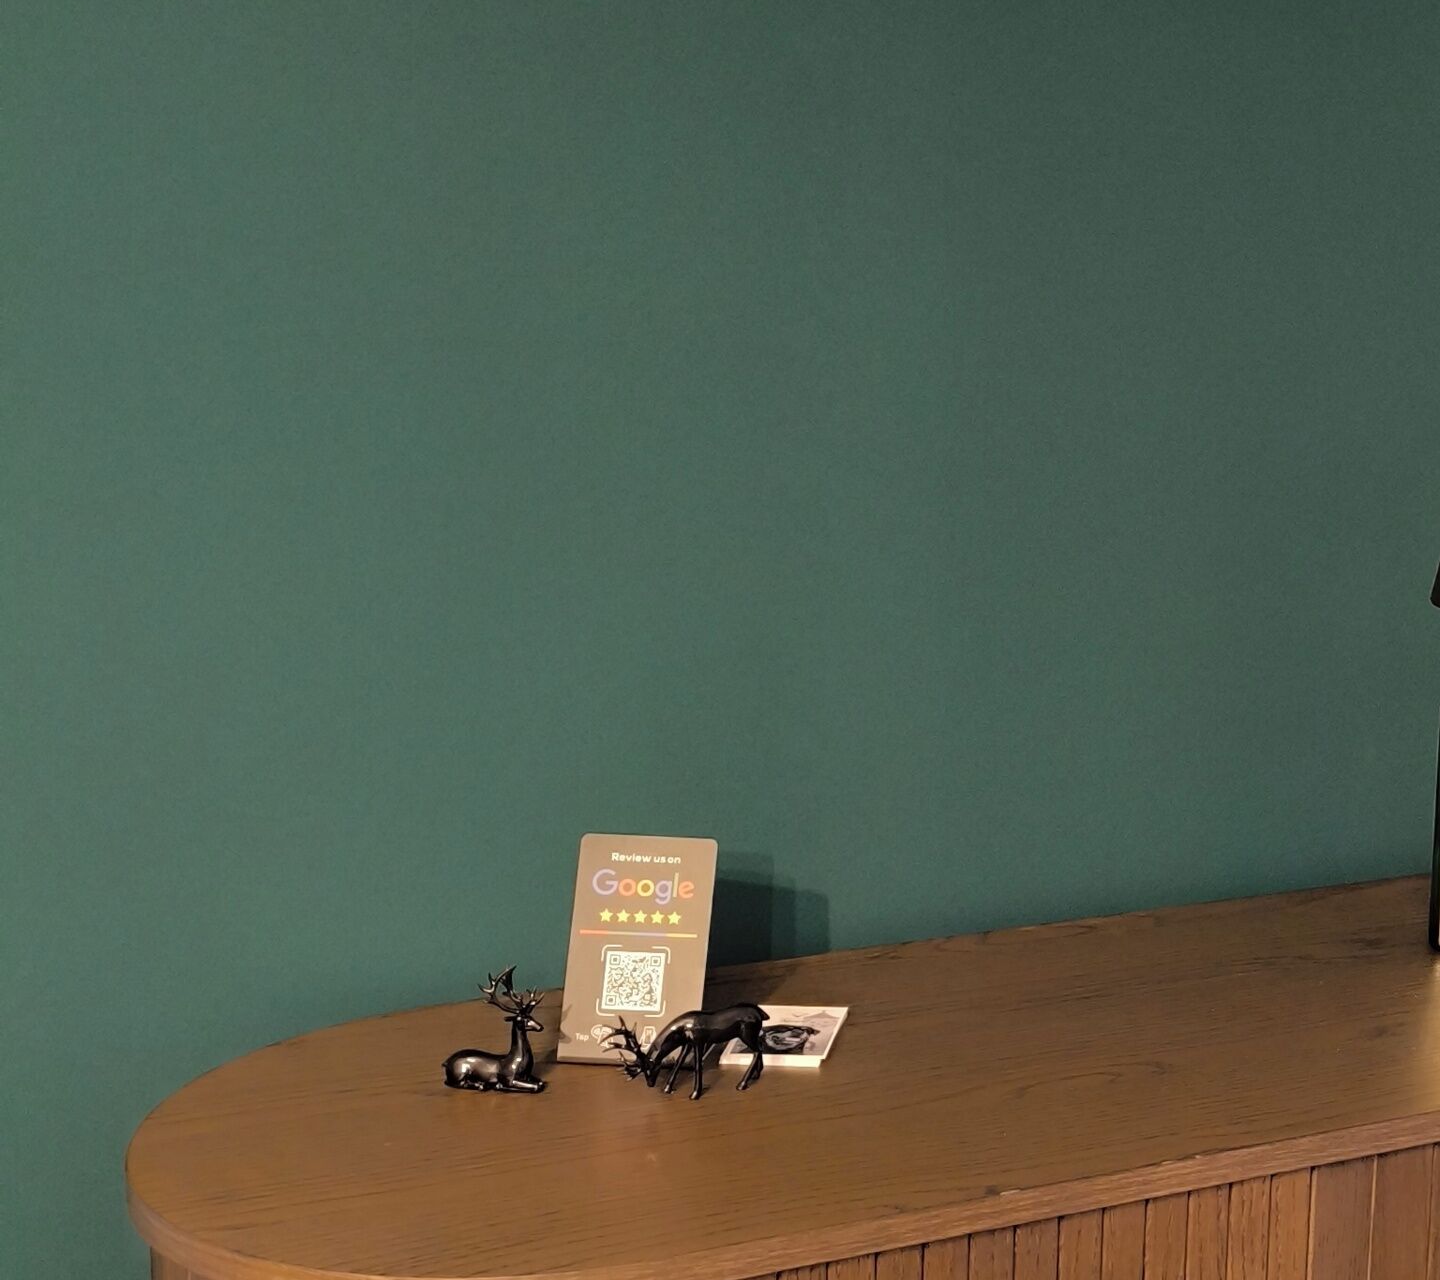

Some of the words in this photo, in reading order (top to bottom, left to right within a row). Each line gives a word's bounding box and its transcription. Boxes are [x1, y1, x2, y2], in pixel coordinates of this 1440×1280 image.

[611, 852, 652, 863] Review
[653, 856, 666, 864] us
[667, 856, 682, 865] on
[592, 868, 695, 905] Google
[575, 1032, 590, 1043] Tap
